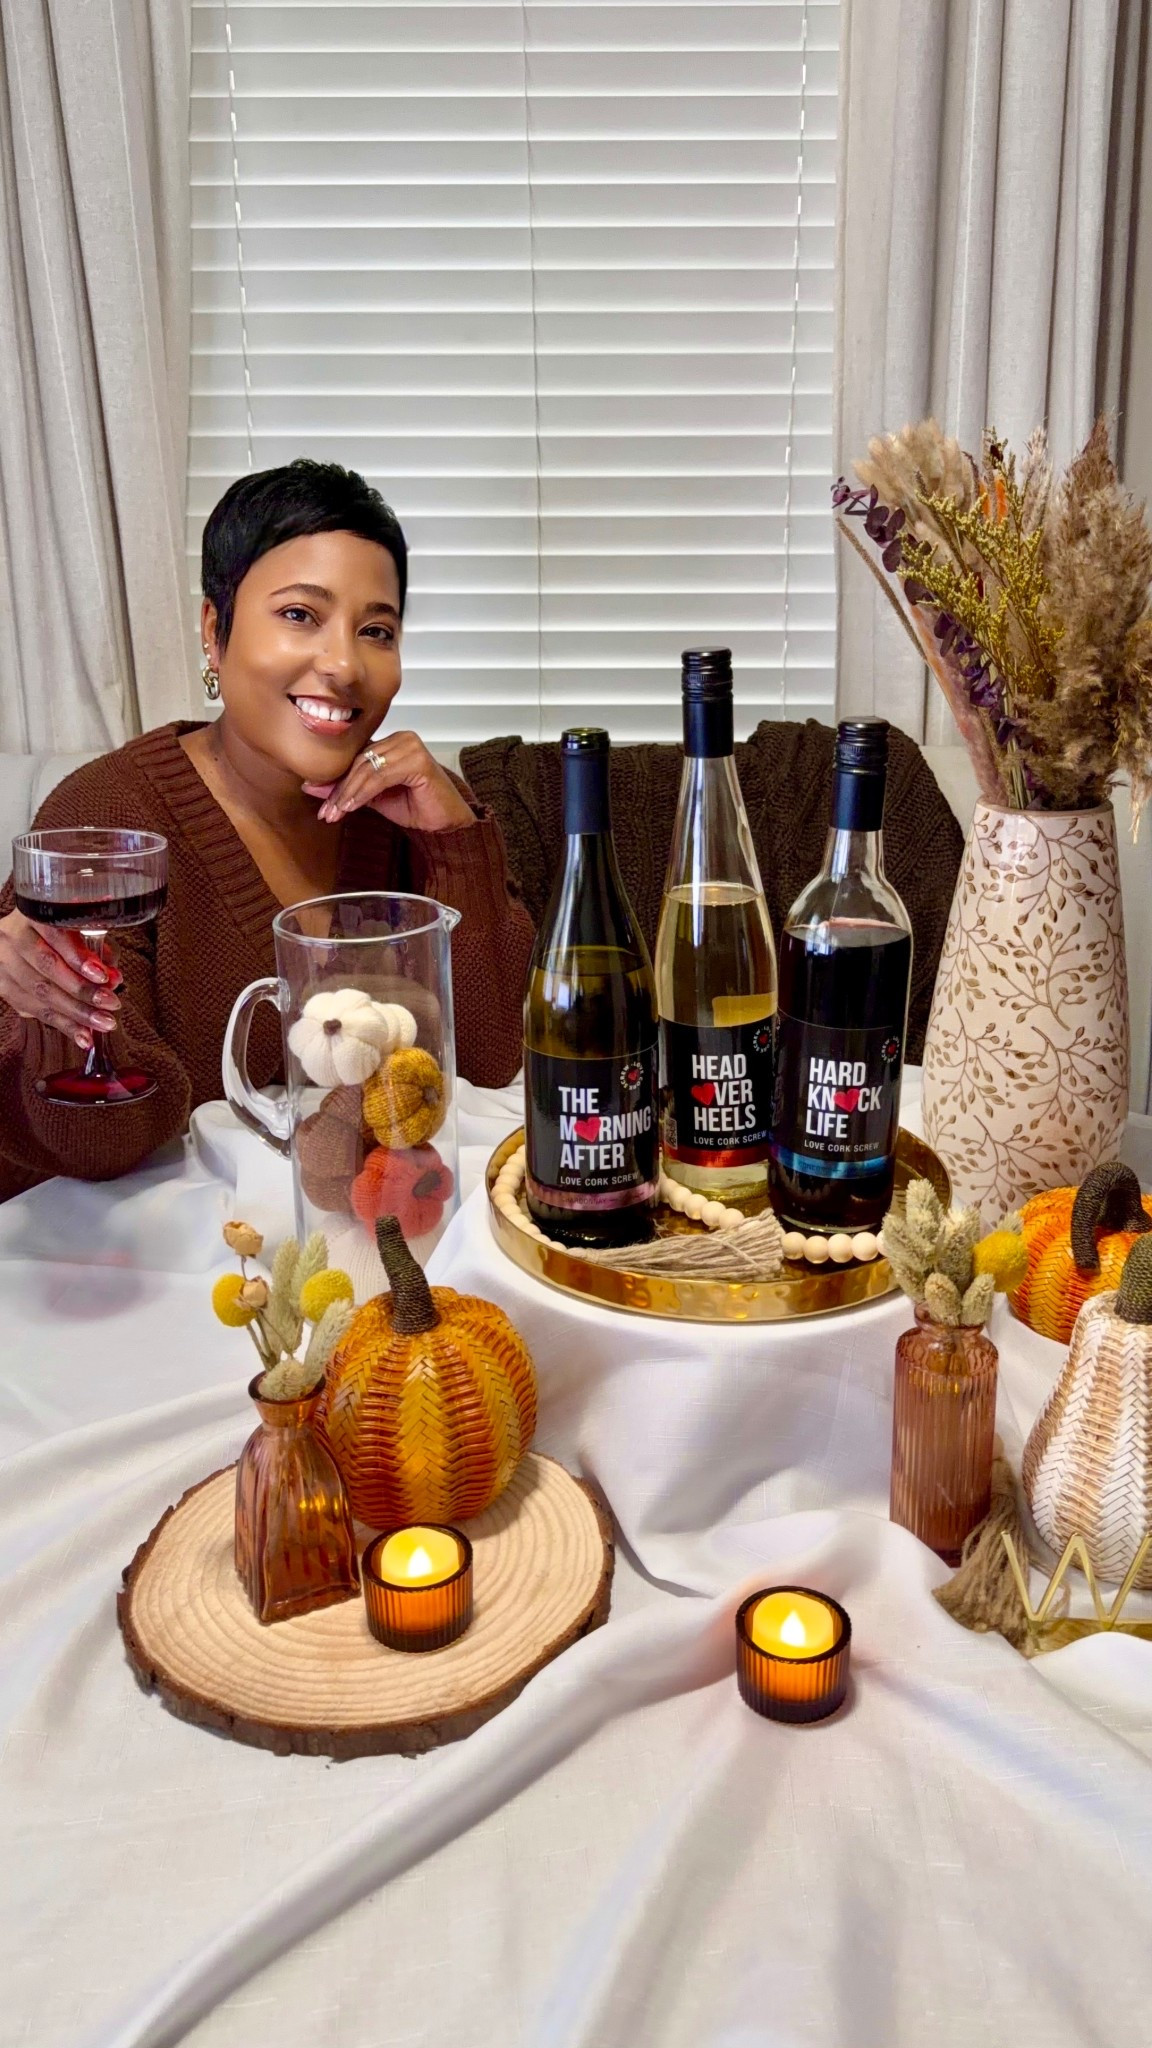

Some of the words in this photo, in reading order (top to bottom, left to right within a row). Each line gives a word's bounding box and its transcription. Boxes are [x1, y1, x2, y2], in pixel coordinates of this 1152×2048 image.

[691, 1053, 747, 1080] HEAD
[809, 1056, 867, 1086] HARD
[558, 1085, 600, 1114] THE
[691, 1078, 753, 1106] VER
[807, 1083, 883, 1113] KNCK
[559, 1105, 652, 1142] MRNING
[693, 1104, 756, 1132] HEELS
[805, 1109, 849, 1139] LIFE
[694, 1136, 715, 1146] LOVE
[717, 1136, 740, 1146] CORK
[742, 1129, 767, 1143] SCREW
[804, 1139, 825, 1151] LOVE
[827, 1143, 851, 1153] CORK
[853, 1141, 880, 1153] SCREW
[560, 1142, 625, 1170] AFTER
[560, 1175, 582, 1186] LOVE
[584, 1177, 609, 1187] CORK
[611, 1171, 639, 1185] SCREW
